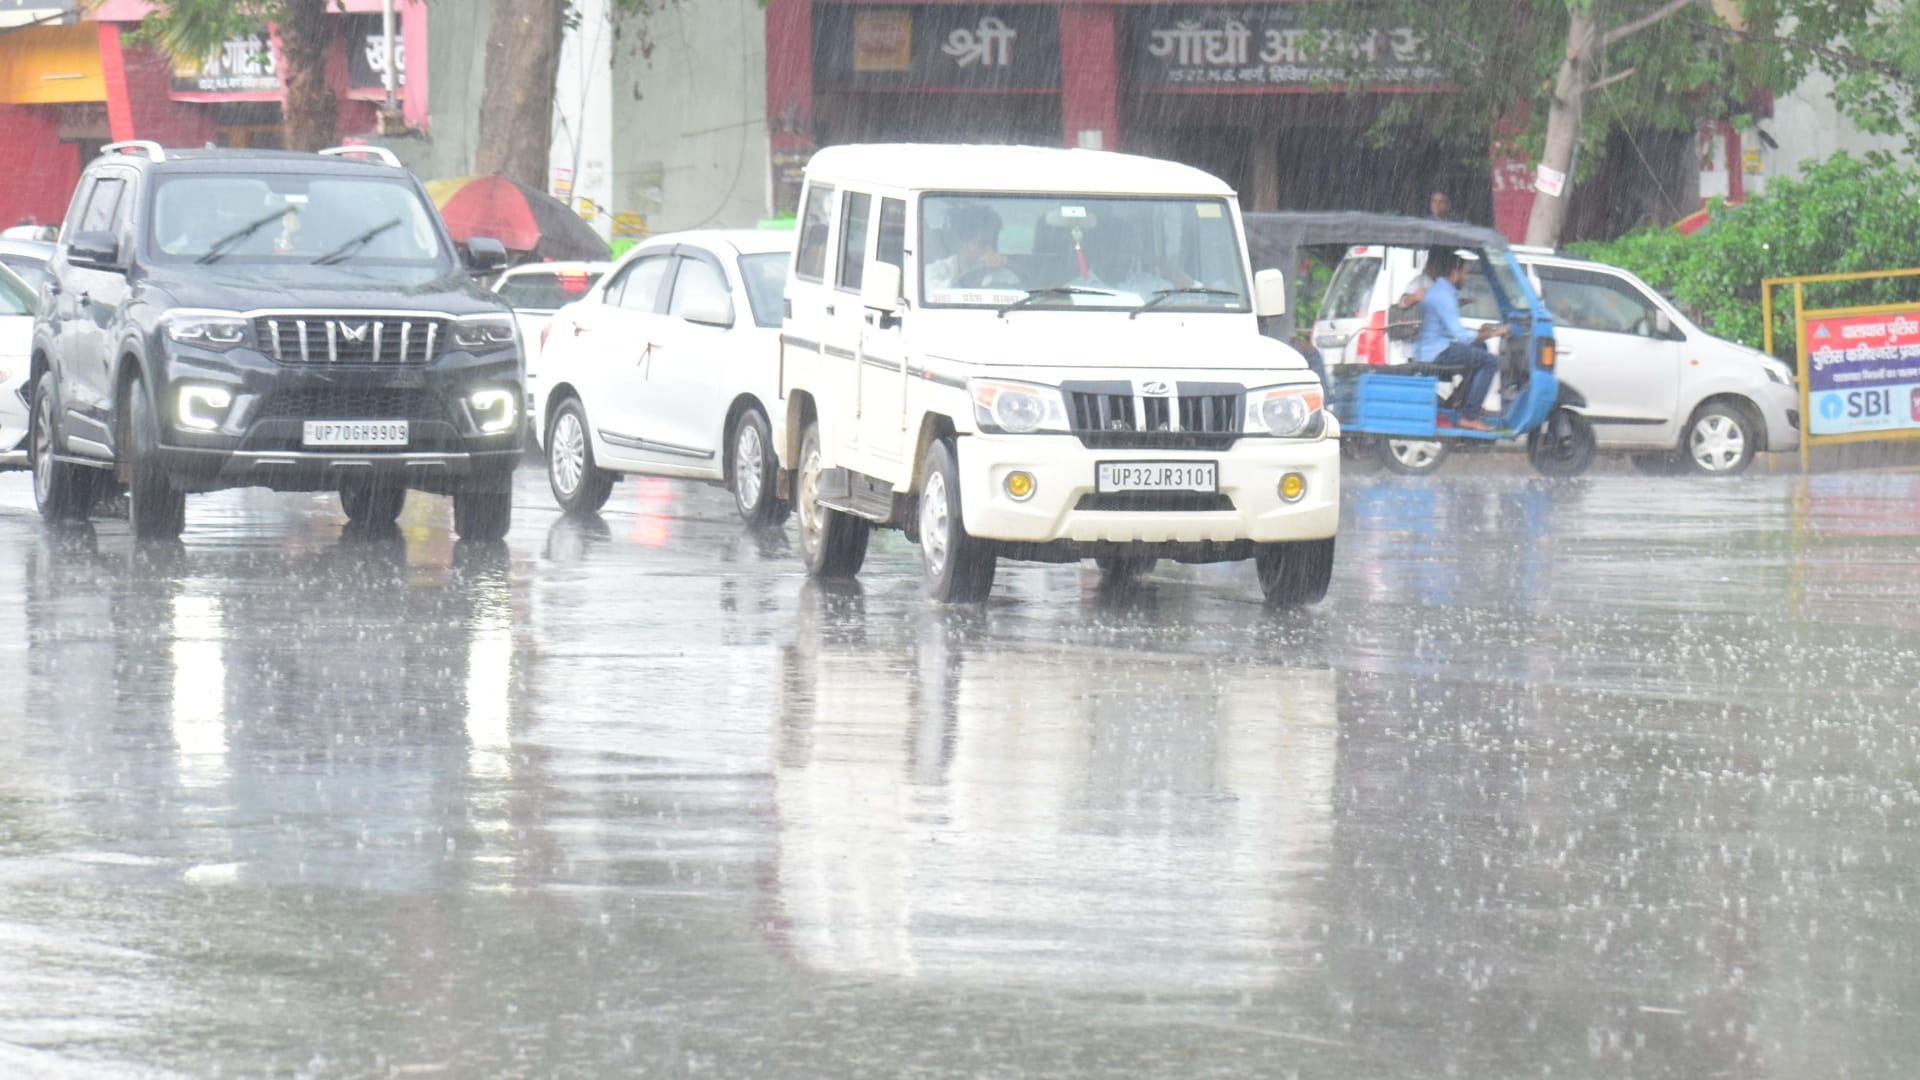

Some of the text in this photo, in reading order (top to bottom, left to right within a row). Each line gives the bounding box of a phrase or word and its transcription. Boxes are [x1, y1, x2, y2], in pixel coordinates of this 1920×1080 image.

[940, 16, 1017, 68] श्री
[1847, 389, 1891, 418] SBI
[315, 425, 406, 441] UP70GH9909
[1112, 467, 1214, 486] UP32JR3101
